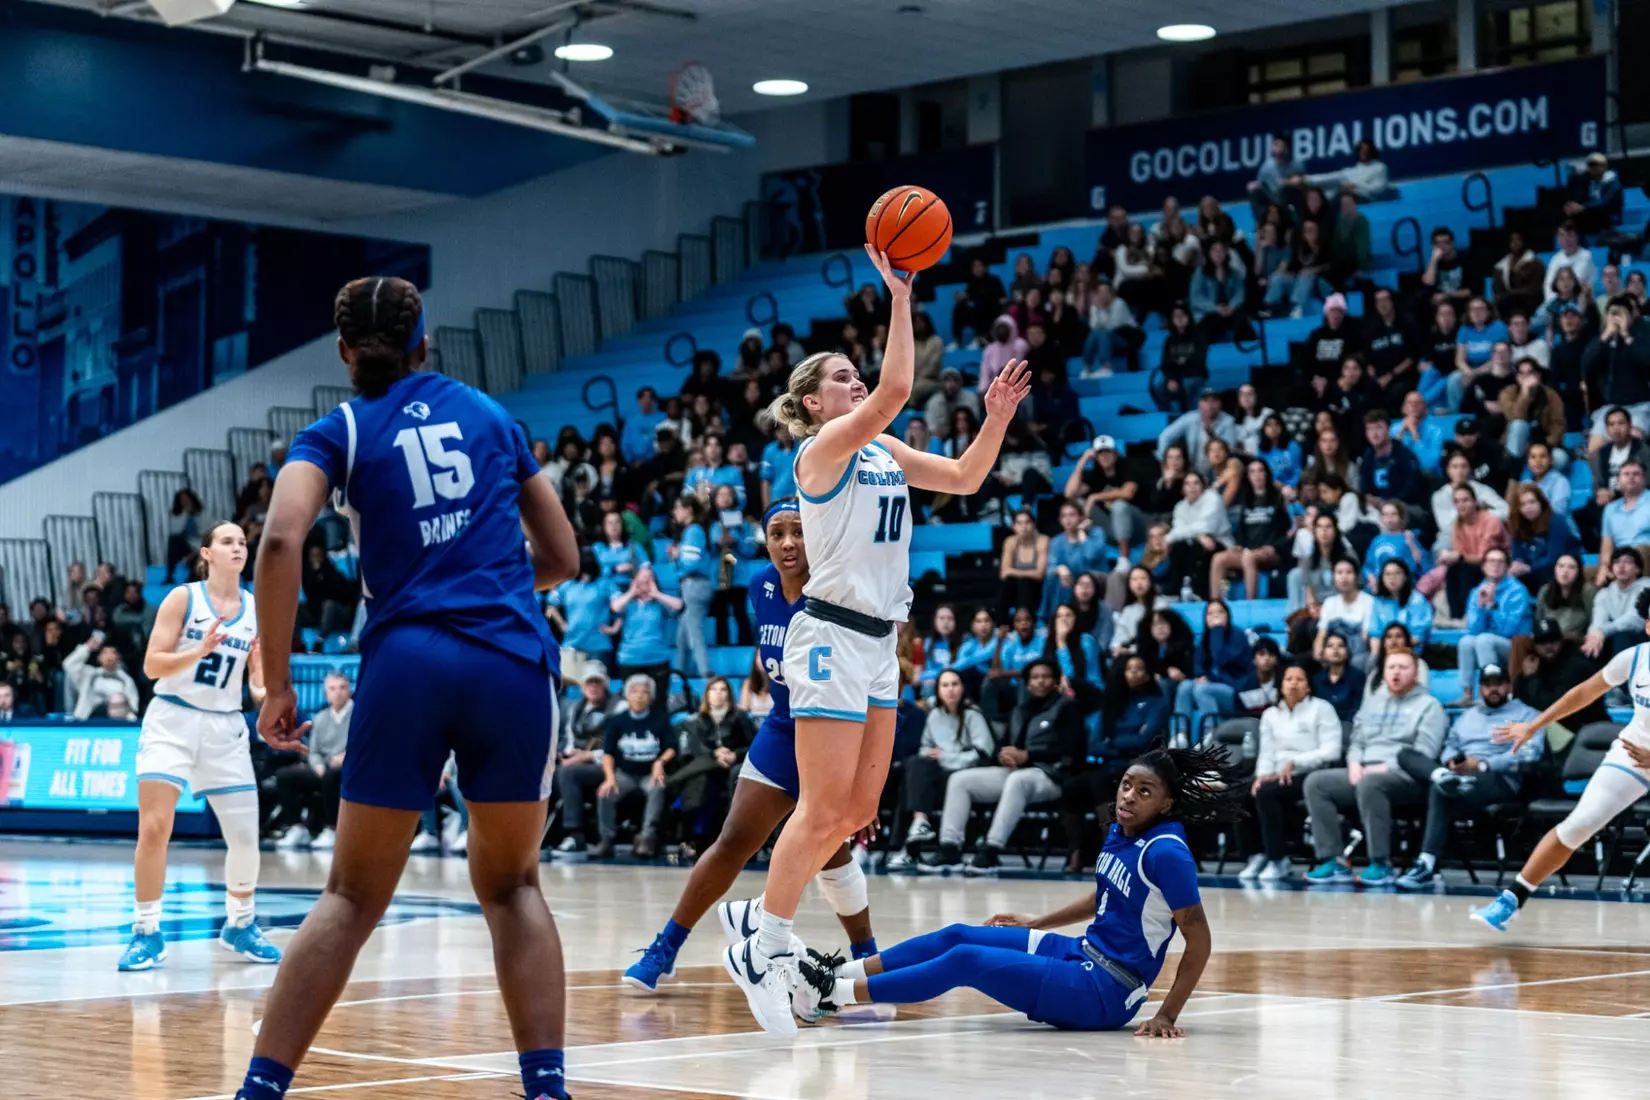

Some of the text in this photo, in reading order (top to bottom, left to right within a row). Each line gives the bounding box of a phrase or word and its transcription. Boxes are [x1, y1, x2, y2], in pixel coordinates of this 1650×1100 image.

[13, 196, 36, 370] APOLLO
[392, 421, 476, 509] 15
[873, 495, 907, 543] 10
[193, 651, 238, 689] 21
[808, 645, 833, 681] C
[64, 738, 122, 766] FIT FOR
[49, 770, 128, 797] ALL TIMES
[1107, 857, 1132, 898] HALL
